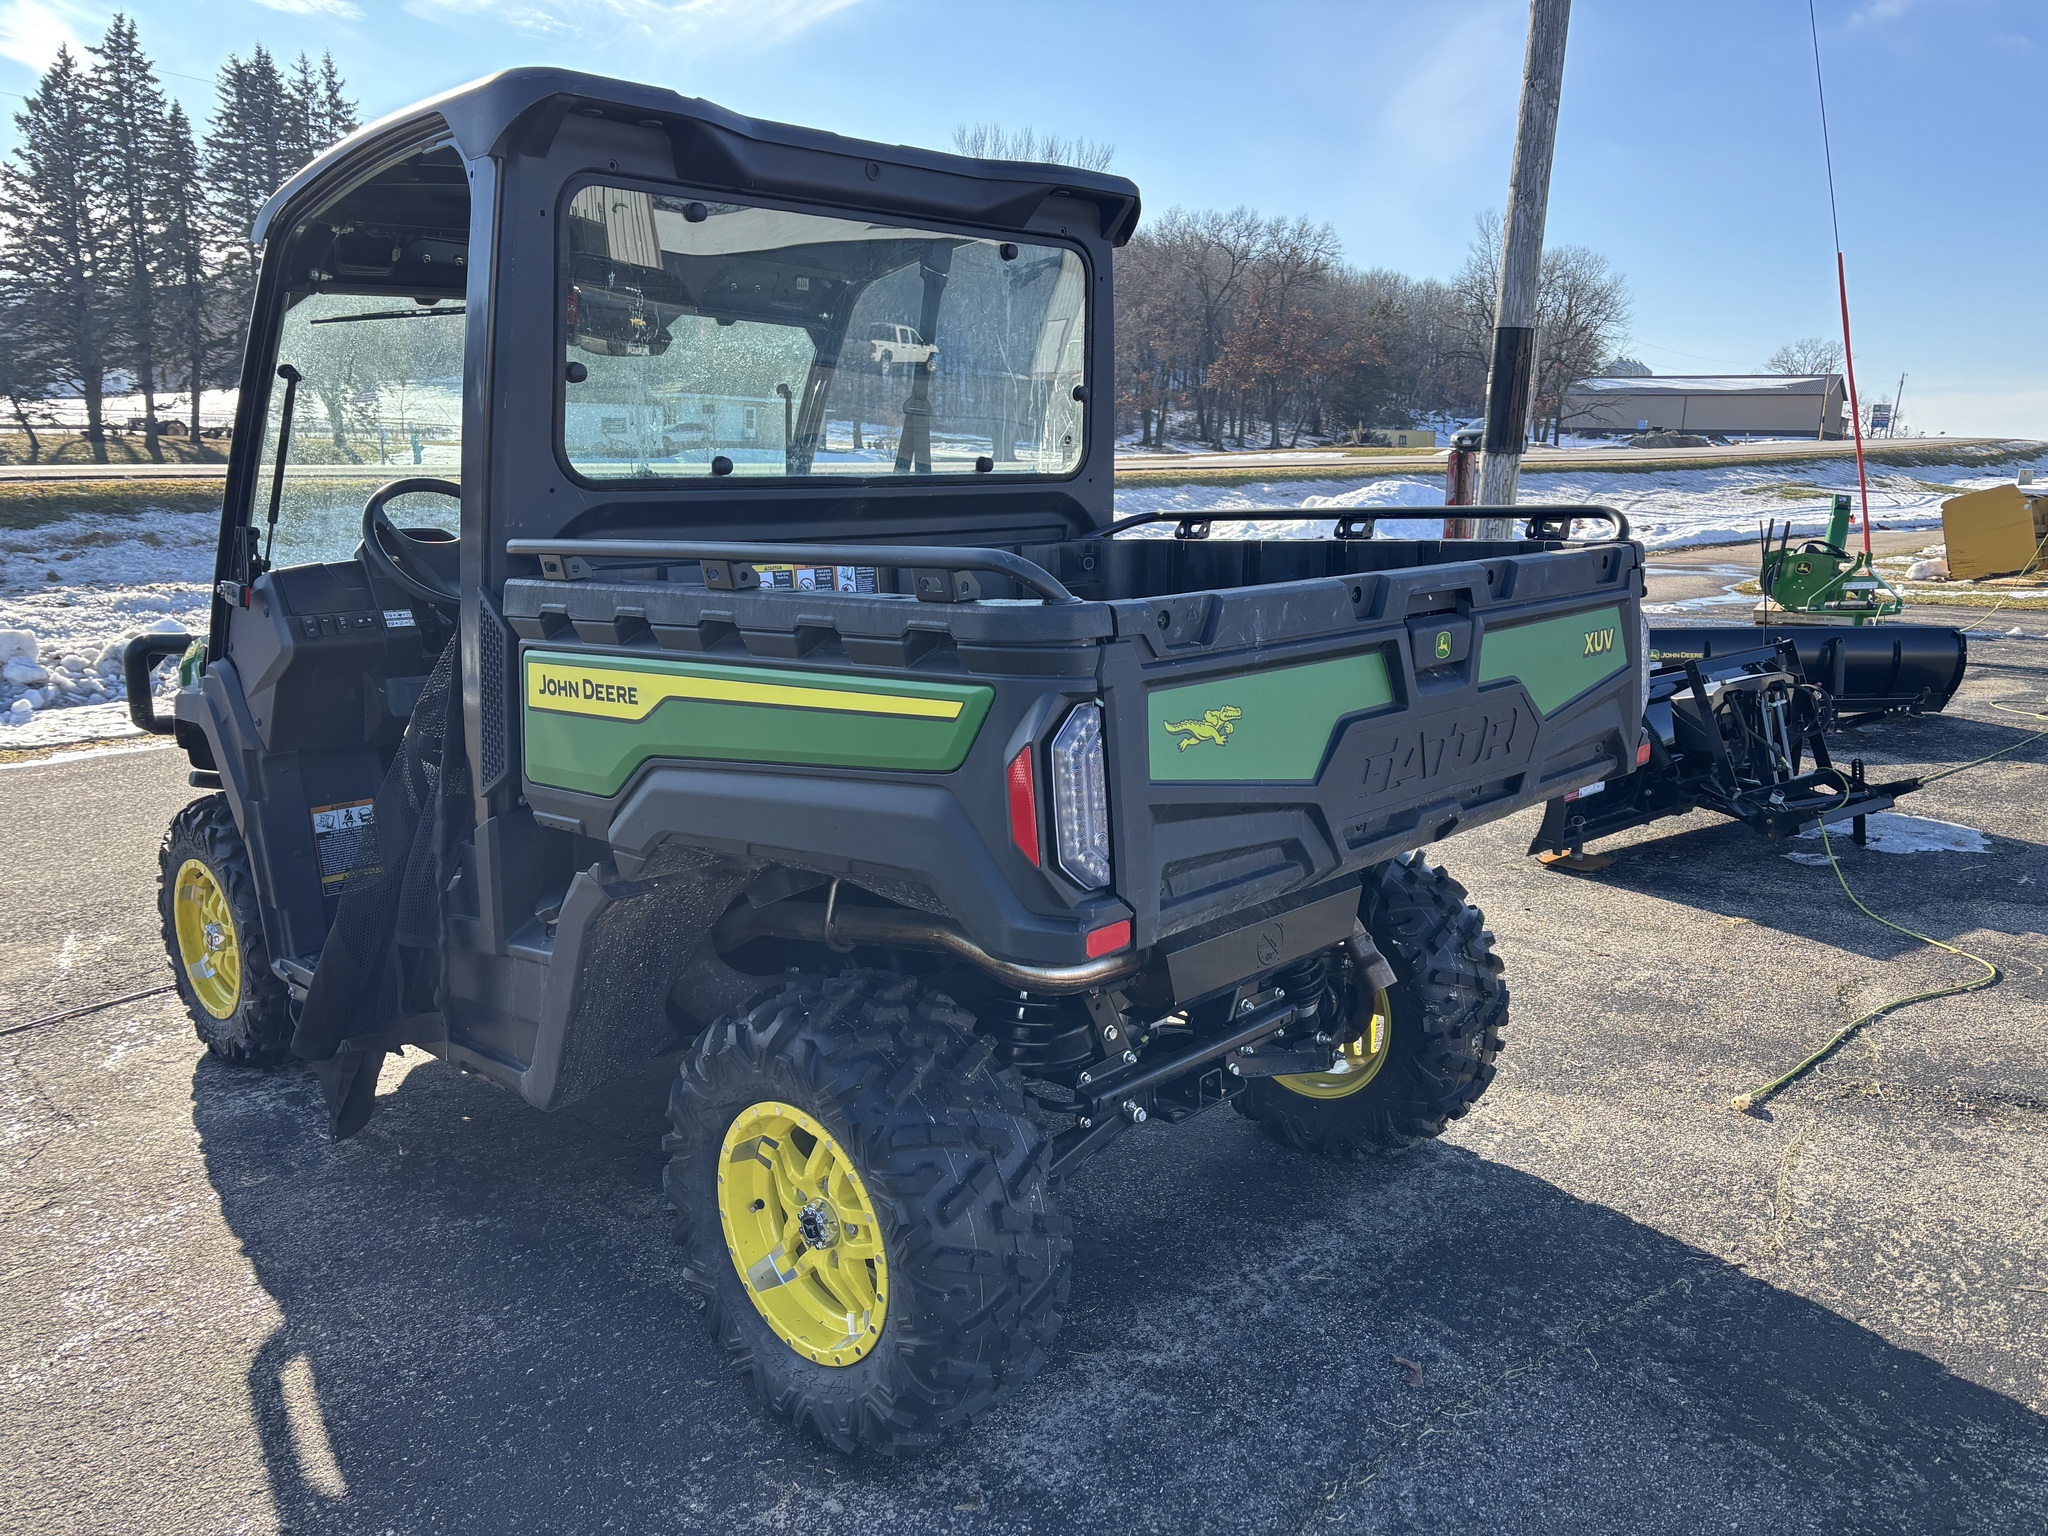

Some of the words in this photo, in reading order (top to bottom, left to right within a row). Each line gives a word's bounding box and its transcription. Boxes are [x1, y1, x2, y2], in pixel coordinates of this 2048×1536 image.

[1583, 627, 1615, 658] XUV
[1681, 651, 1704, 659] DEERE
[539, 674, 580, 699] JOHN
[582, 678, 639, 705] DEERE
[1355, 706, 1518, 799] GATOR
